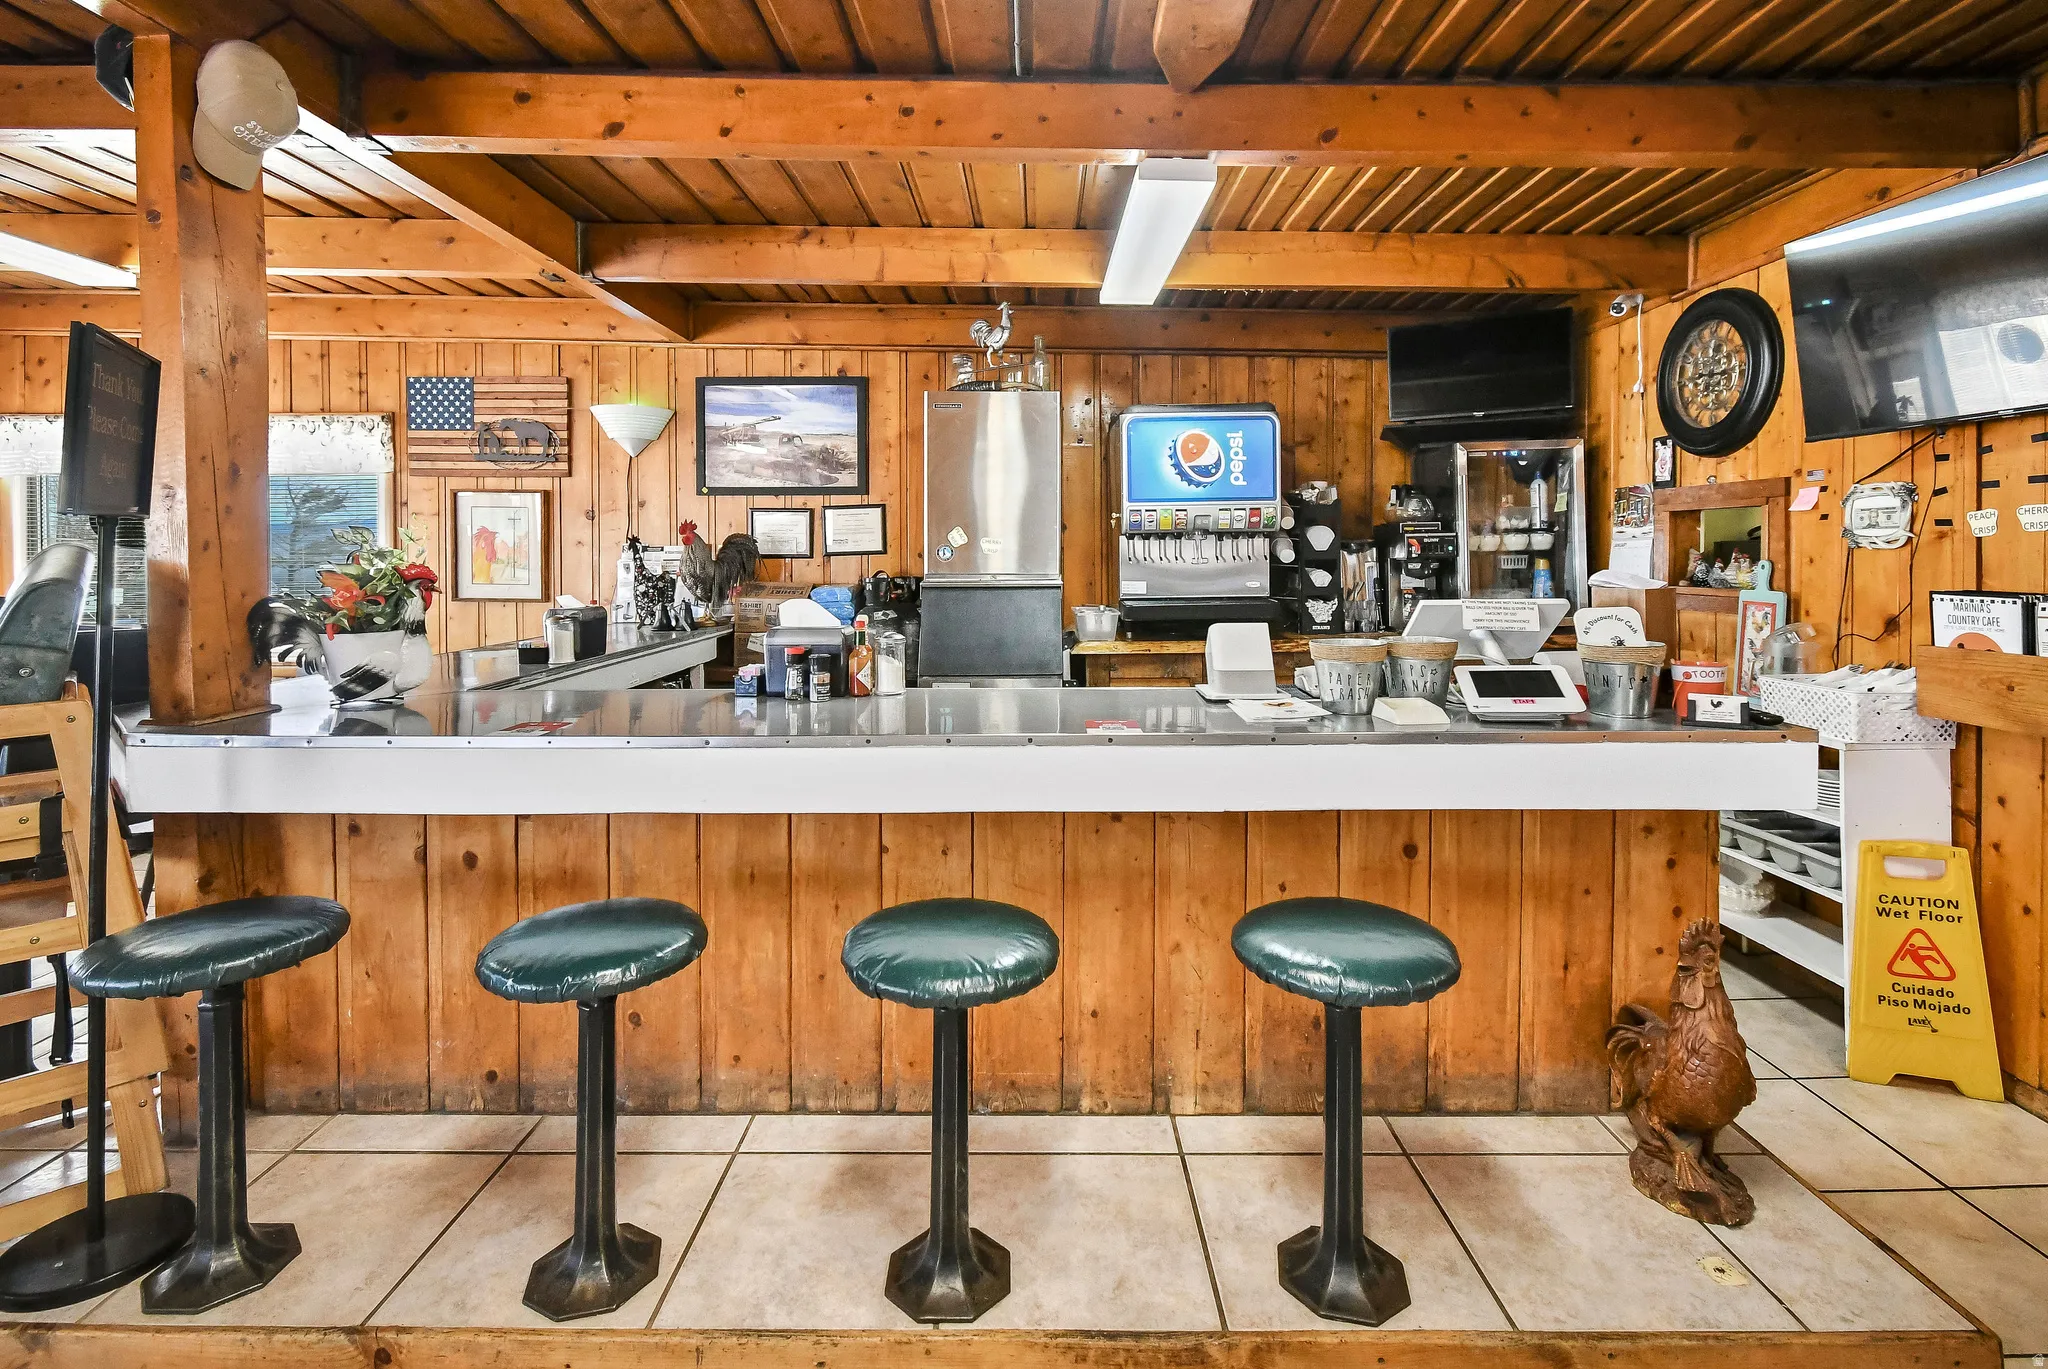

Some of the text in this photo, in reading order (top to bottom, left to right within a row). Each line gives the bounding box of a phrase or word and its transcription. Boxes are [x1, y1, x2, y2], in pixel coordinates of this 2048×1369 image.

[92, 362, 144, 405] Thank You
[1226, 430, 1248, 486] pepsi
[100, 453, 127, 484] Again
[1968, 511, 1996, 521] PEACH
[1973, 525, 1996, 536] CRISP
[1953, 602, 1992, 614] MARINIA'S
[1587, 614, 1614, 627] Discount
[1614, 614, 1625, 623] for
[1624, 620, 1638, 635] Cash
[1947, 614, 2001, 628] COUNTRY CAFE
[1328, 672, 1372, 687] PAPER
[1329, 687, 1370, 701] TRASH
[1877, 893, 1960, 910] CAUTION
[1875, 906, 1964, 924] Wet Floor
[1891, 982, 1956, 999] Cuidado
[1877, 995, 1972, 1016] Piso Mojado
